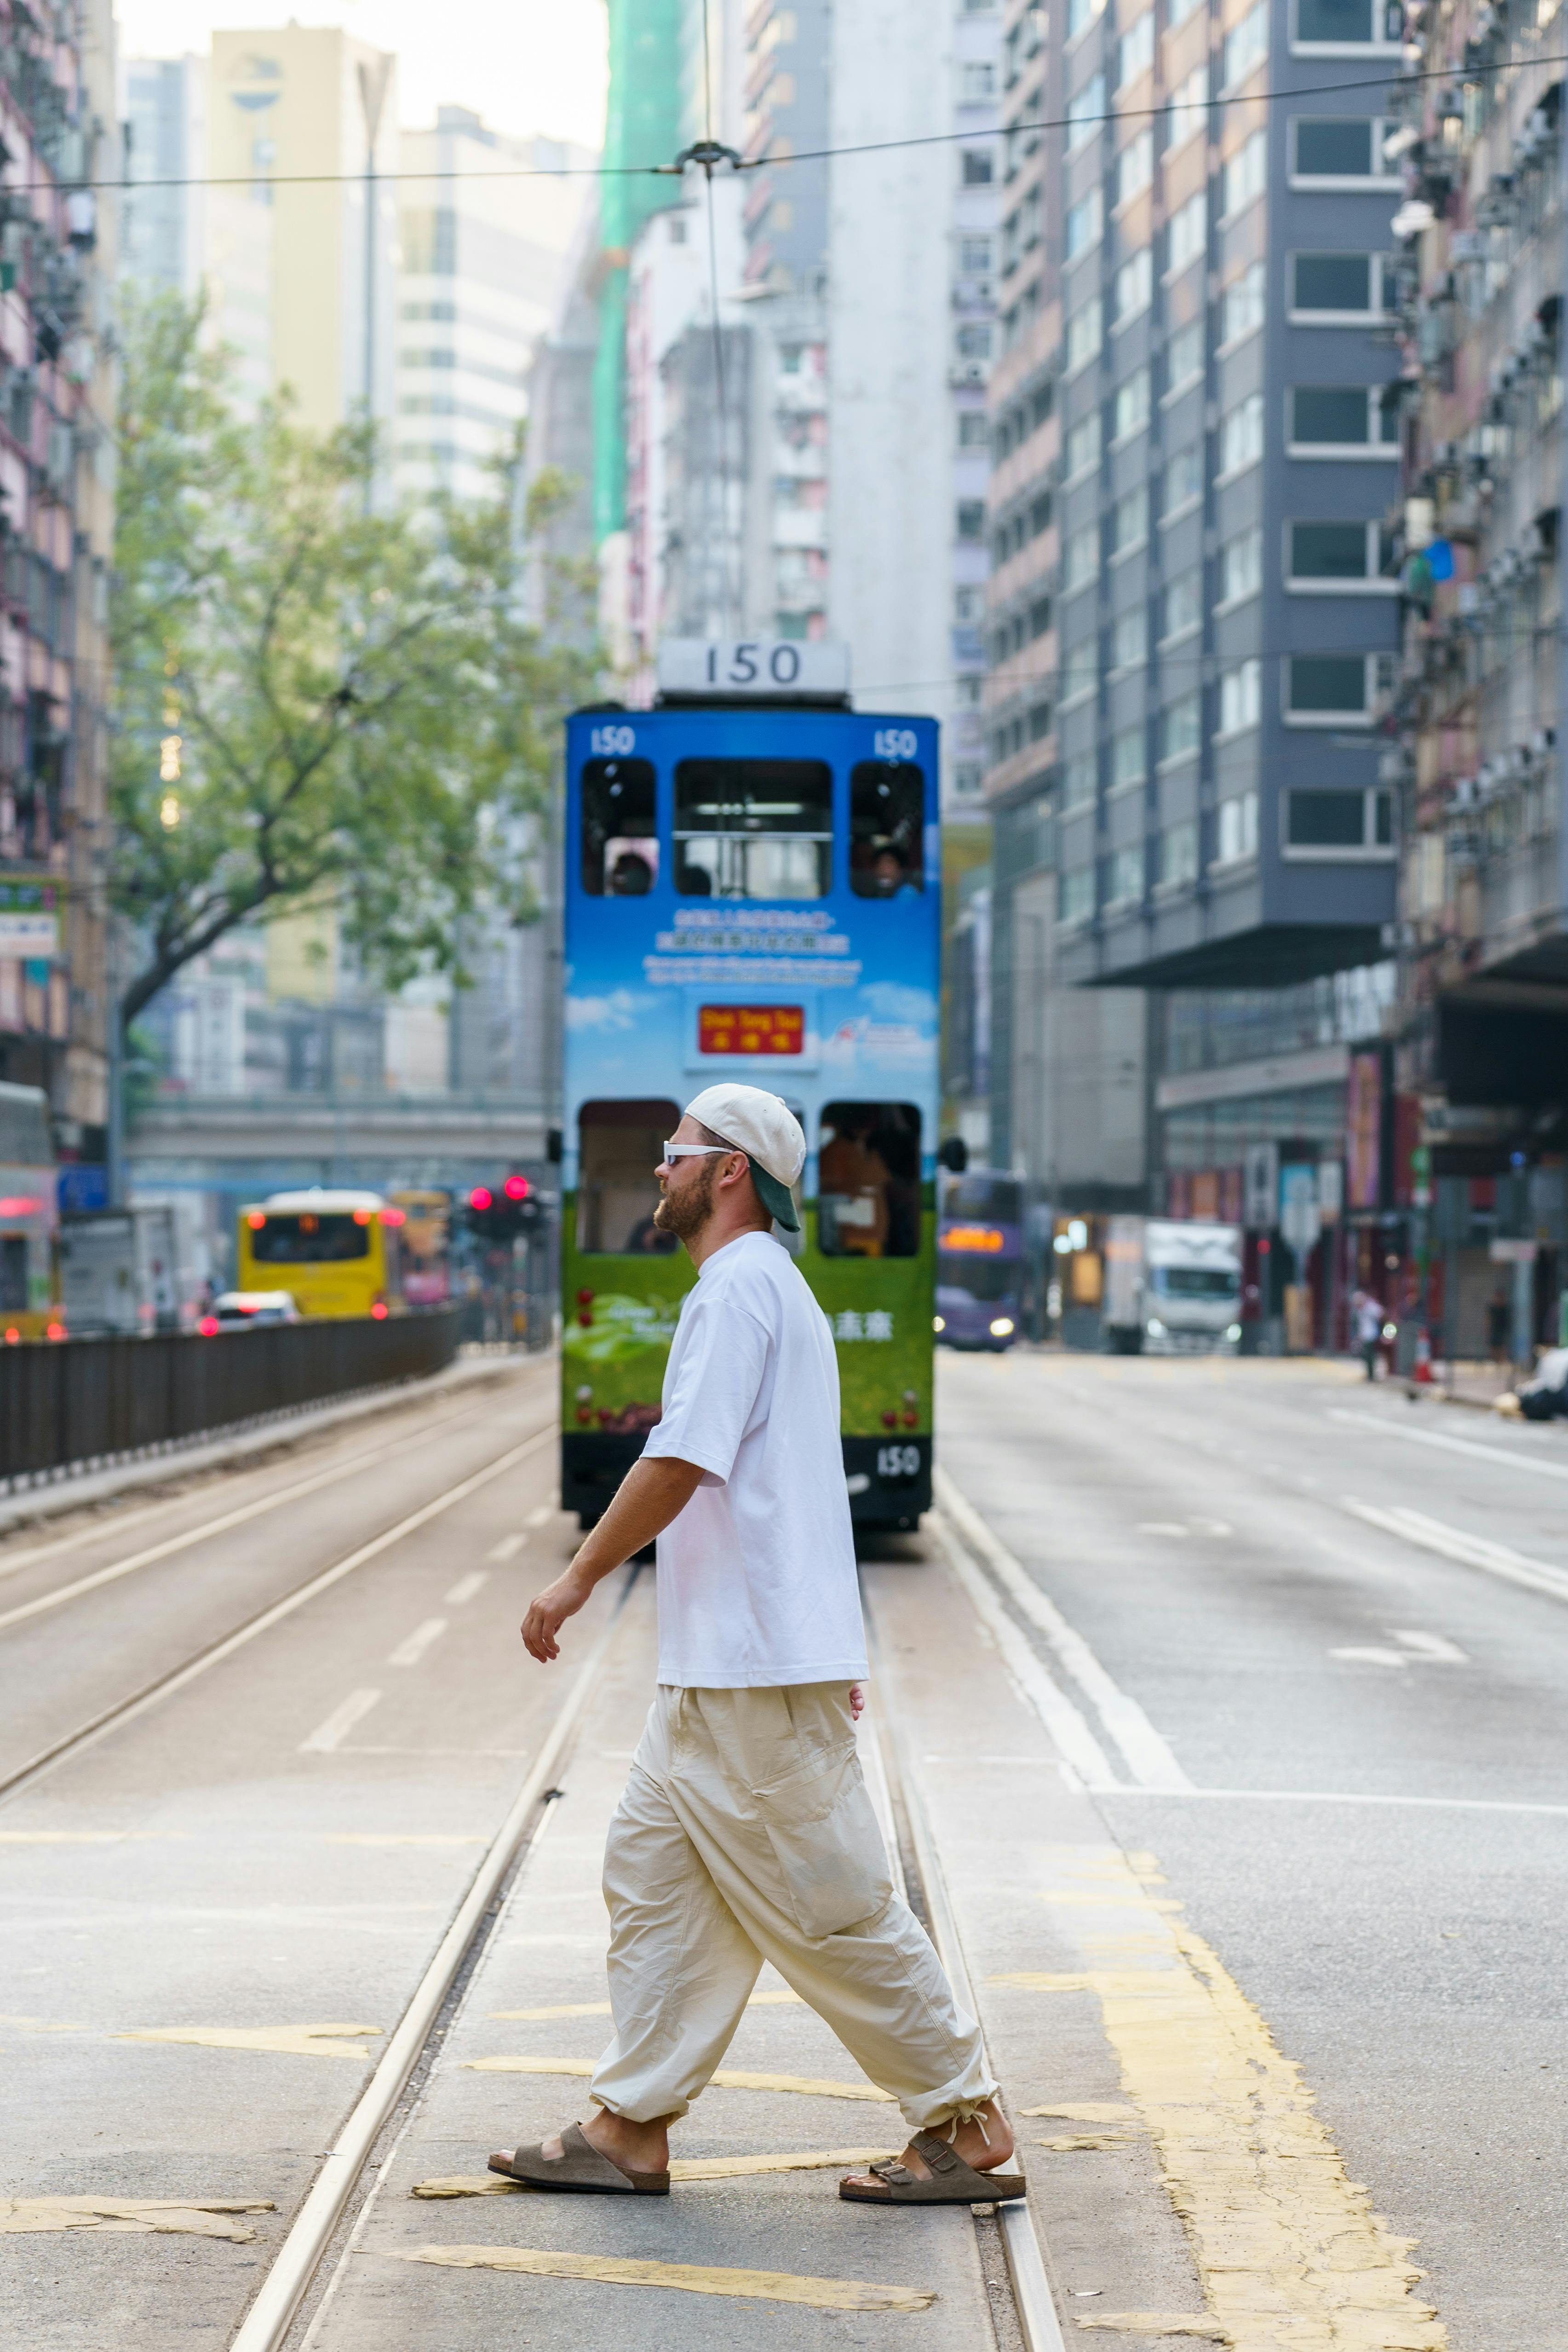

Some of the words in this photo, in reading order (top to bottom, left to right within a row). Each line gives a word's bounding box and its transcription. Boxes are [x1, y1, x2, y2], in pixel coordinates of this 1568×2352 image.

[708, 645, 800, 683] 150
[592, 726, 635, 755] 150
[875, 729, 917, 758] 150
[878, 1446, 919, 1476] 150
